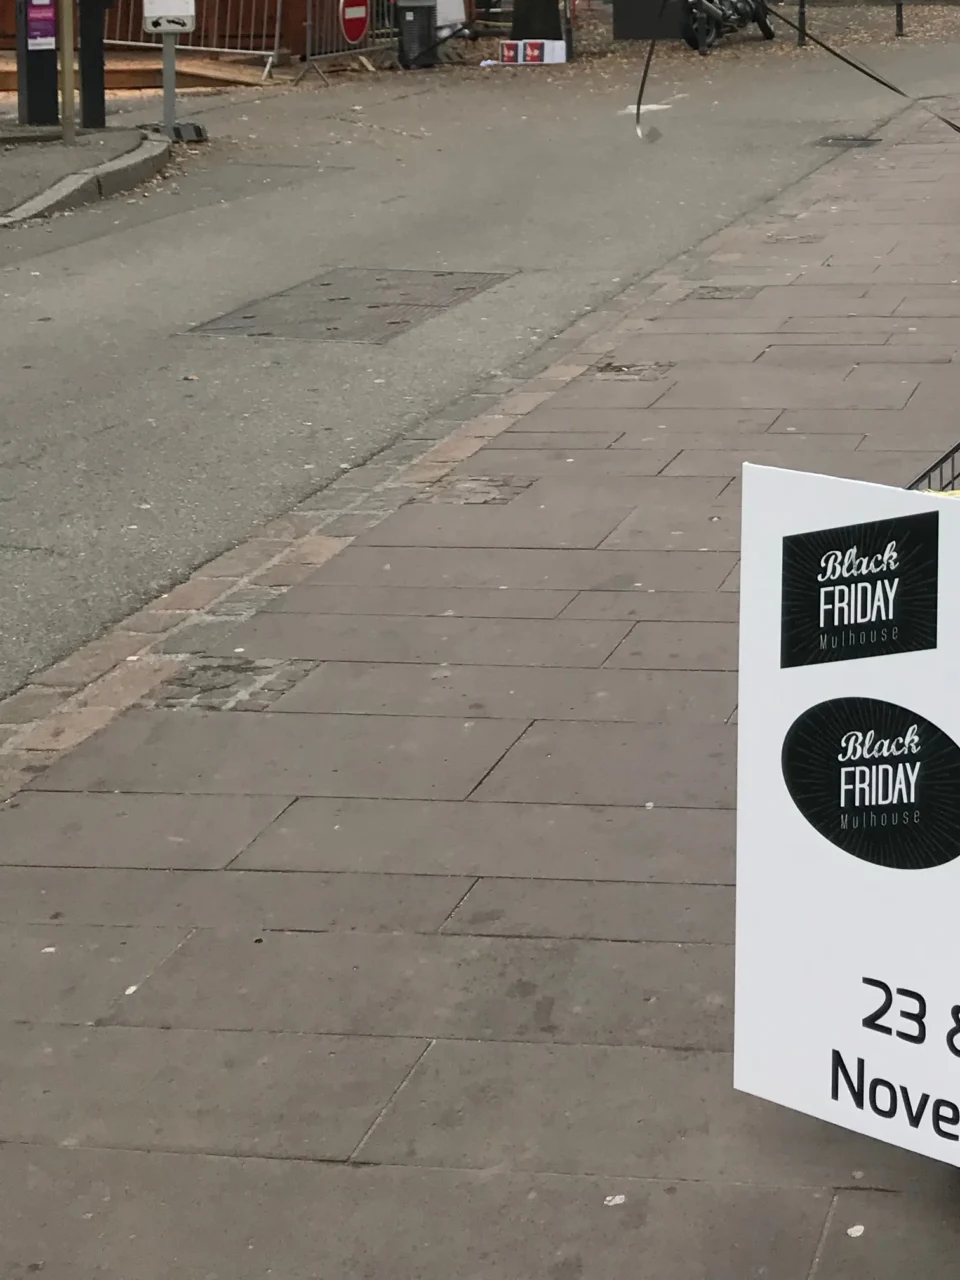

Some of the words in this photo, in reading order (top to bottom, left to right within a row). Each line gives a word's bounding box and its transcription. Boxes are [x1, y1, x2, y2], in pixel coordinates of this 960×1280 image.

[817, 540, 899, 582] Black
[819, 577, 900, 628] FRIDAY
[820, 626, 899, 650] Mulhouse
[837, 723, 921, 762] Black
[840, 761, 921, 807] FRIDAY
[840, 810, 920, 830] Mulhouse
[861, 976, 927, 1045] 23
